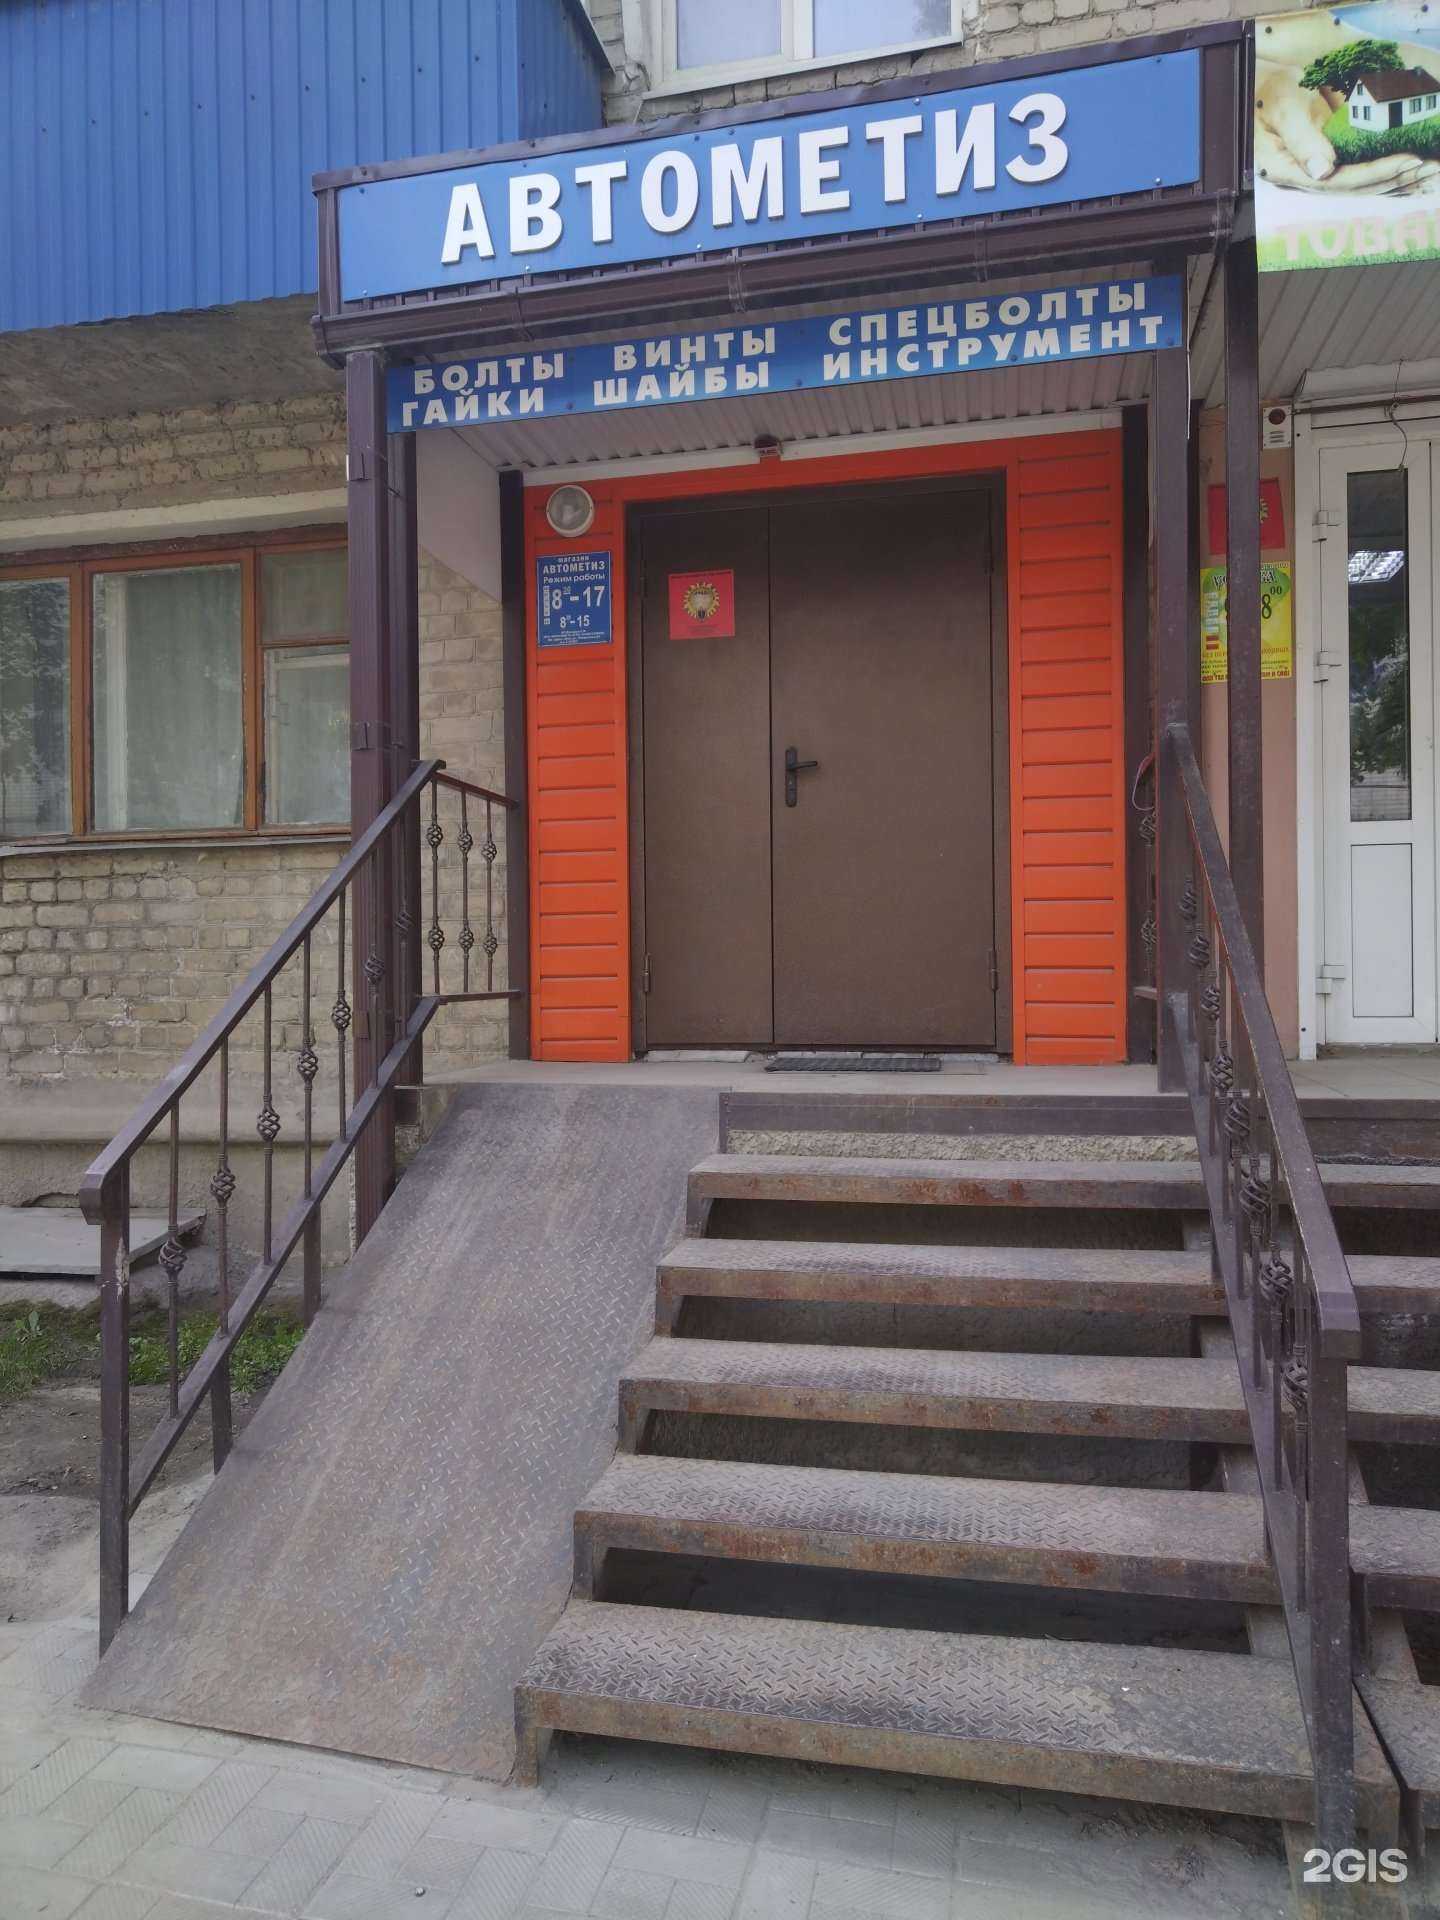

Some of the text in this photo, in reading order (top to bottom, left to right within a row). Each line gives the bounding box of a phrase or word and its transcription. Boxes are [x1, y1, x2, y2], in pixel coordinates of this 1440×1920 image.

[441, 92, 1069, 265] АВТОМЕТИЗ
[402, 315, 1164, 427] ГАЙКИ ШАЙБЫ ИНСТРУМЕНТ
[414, 282, 1146, 395] БОЛТЫ ВИНТЫ СПЕЦБОЛТЫ
[543, 560, 606, 575] АВТОМЕТИЗ
[543, 572, 606, 585] Режим работы
